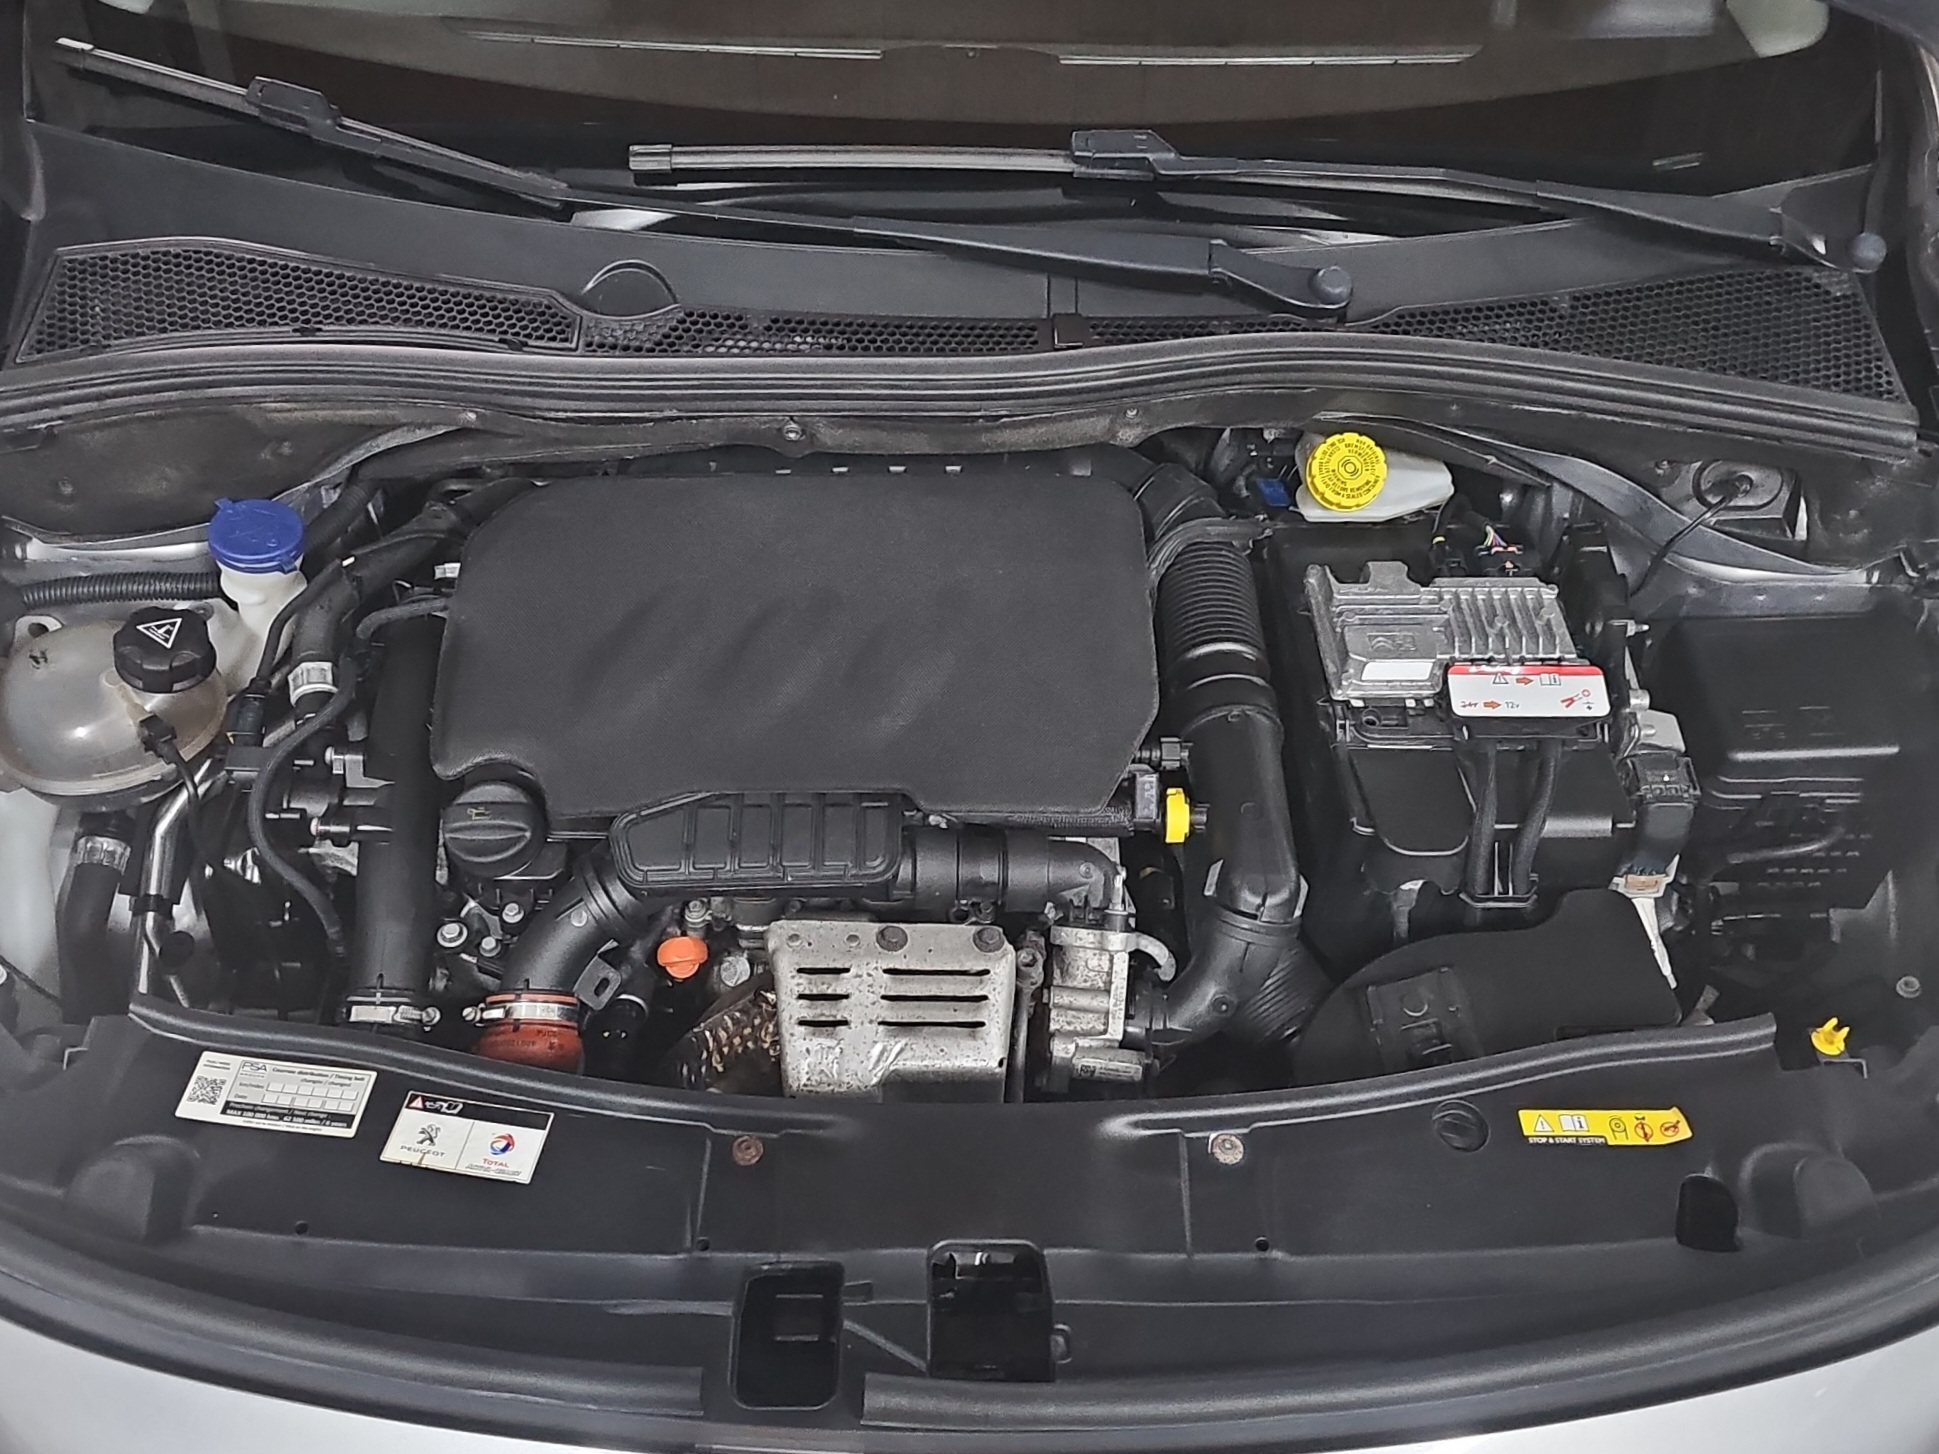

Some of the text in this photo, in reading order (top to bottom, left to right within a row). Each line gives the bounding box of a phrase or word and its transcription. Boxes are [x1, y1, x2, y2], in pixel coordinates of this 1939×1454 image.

[241, 1061, 268, 1072] PSA
[1528, 1136, 1548, 1144] STOP
[1555, 1136, 1577, 1144] START
[1578, 1136, 1606, 1145] SYSTEM
[400, 1145, 446, 1157] PEUGEOT
[482, 1158, 509, 1168] TOTAL
